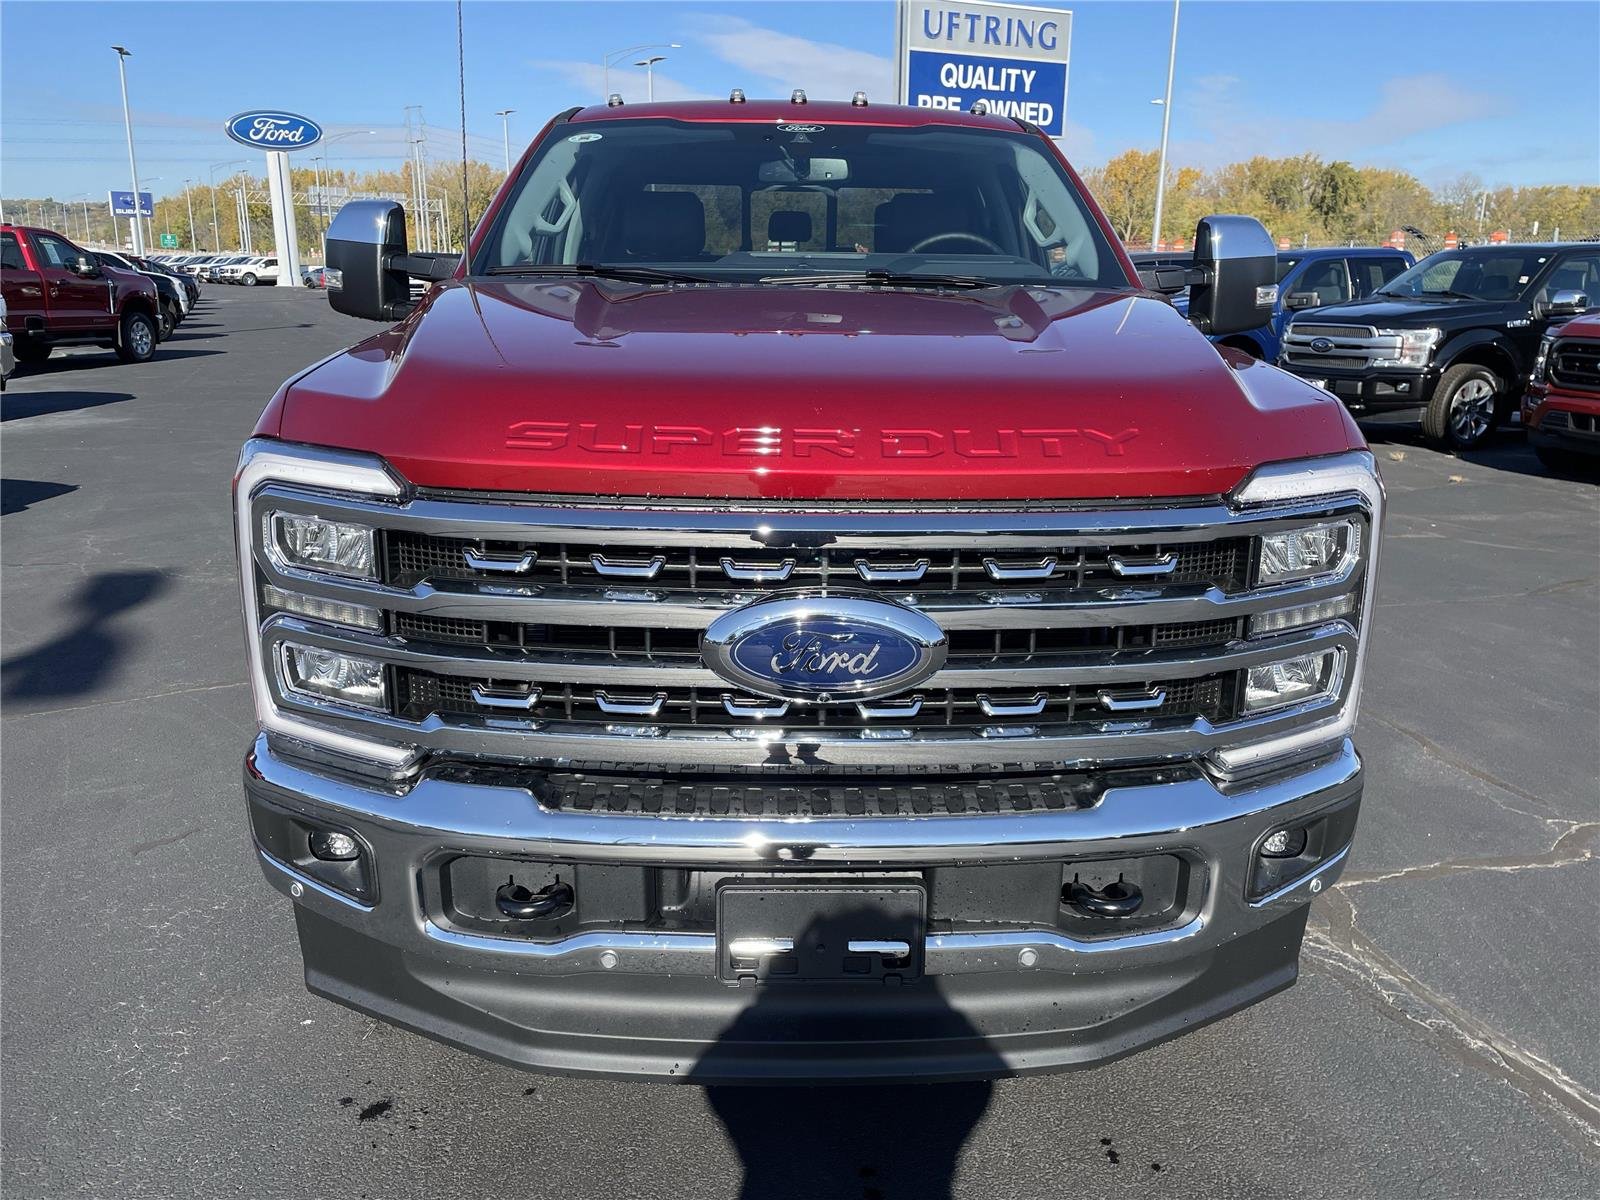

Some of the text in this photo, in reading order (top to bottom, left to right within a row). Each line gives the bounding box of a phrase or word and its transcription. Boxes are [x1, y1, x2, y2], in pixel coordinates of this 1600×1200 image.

[923, 9, 1058, 50] UFTRING
[940, 62, 1037, 94] QUALITY
[249, 117, 305, 142] Ford
[505, 421, 1139, 458] SUPER DUTY
[770, 630, 882, 675] Ford
